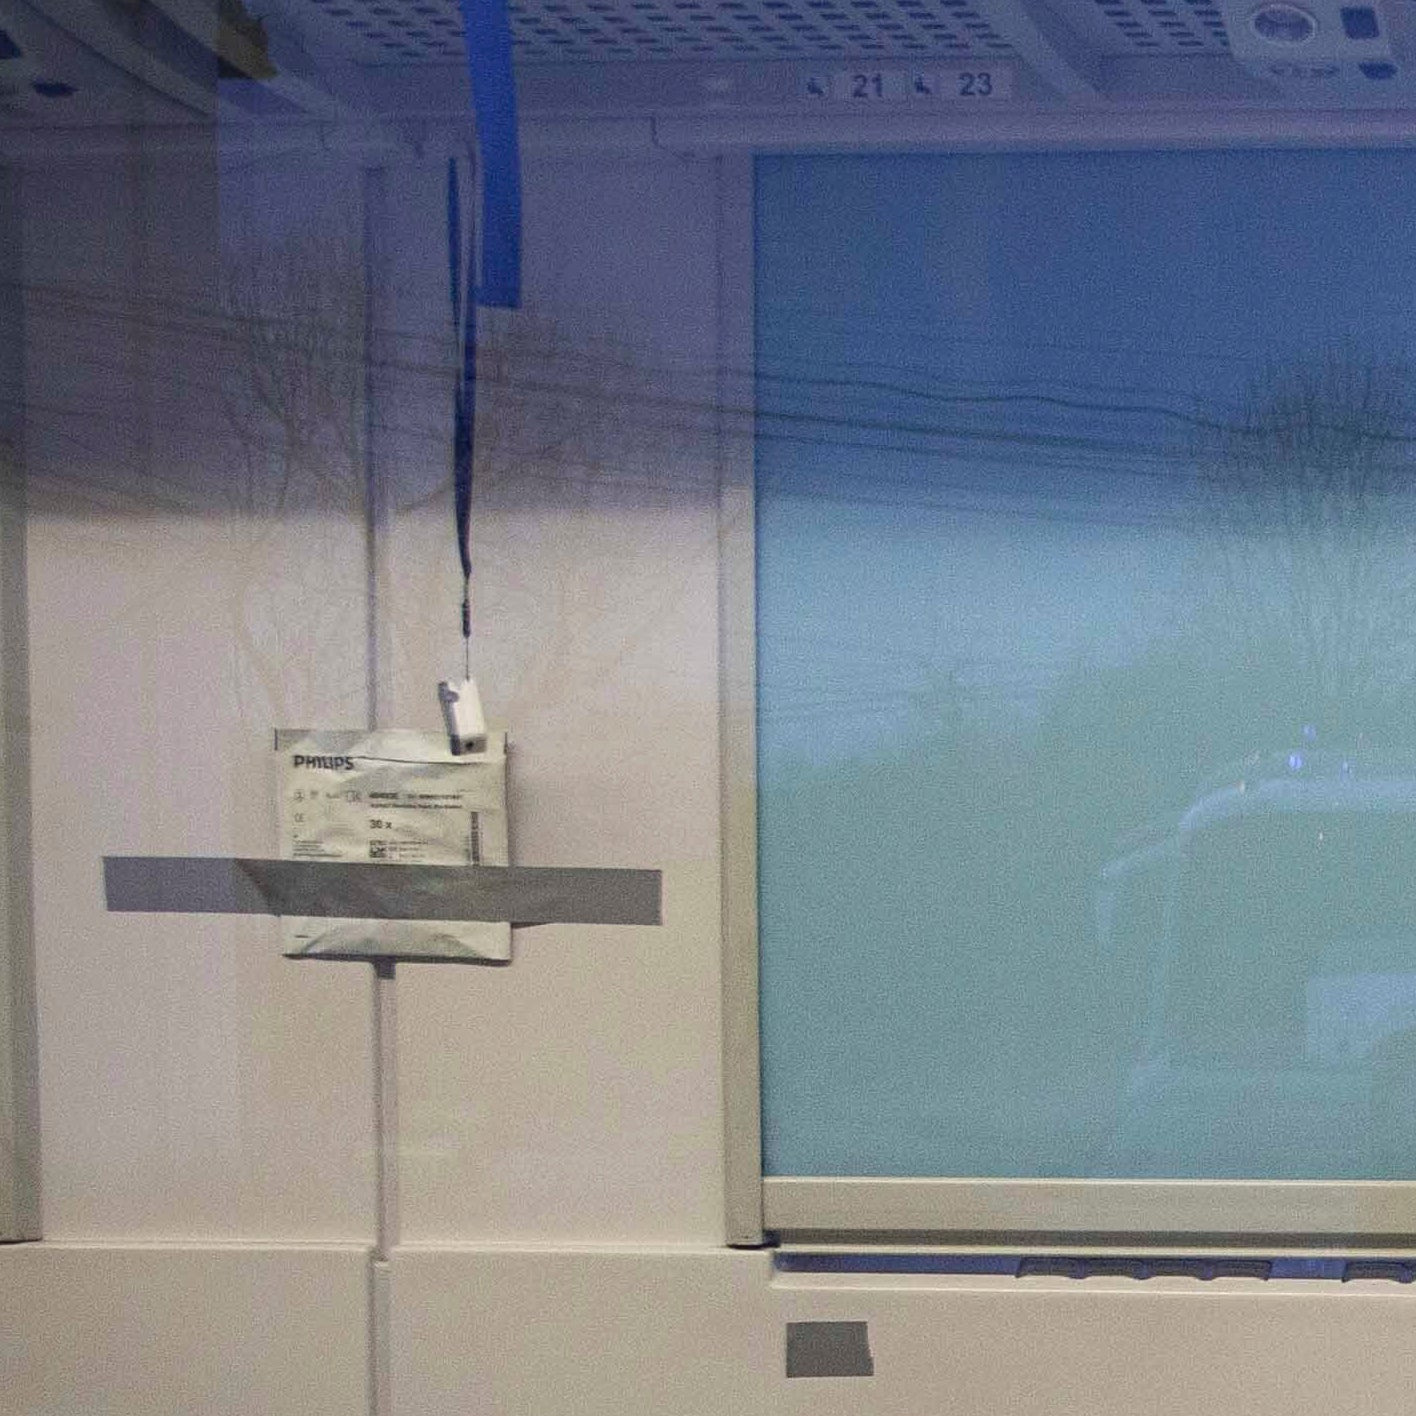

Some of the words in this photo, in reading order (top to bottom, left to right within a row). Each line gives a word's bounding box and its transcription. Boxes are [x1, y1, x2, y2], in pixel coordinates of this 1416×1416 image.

[852, 73, 885, 98] 21
[958, 72, 992, 97] 23
[293, 754, 355, 770] PHILIPS
